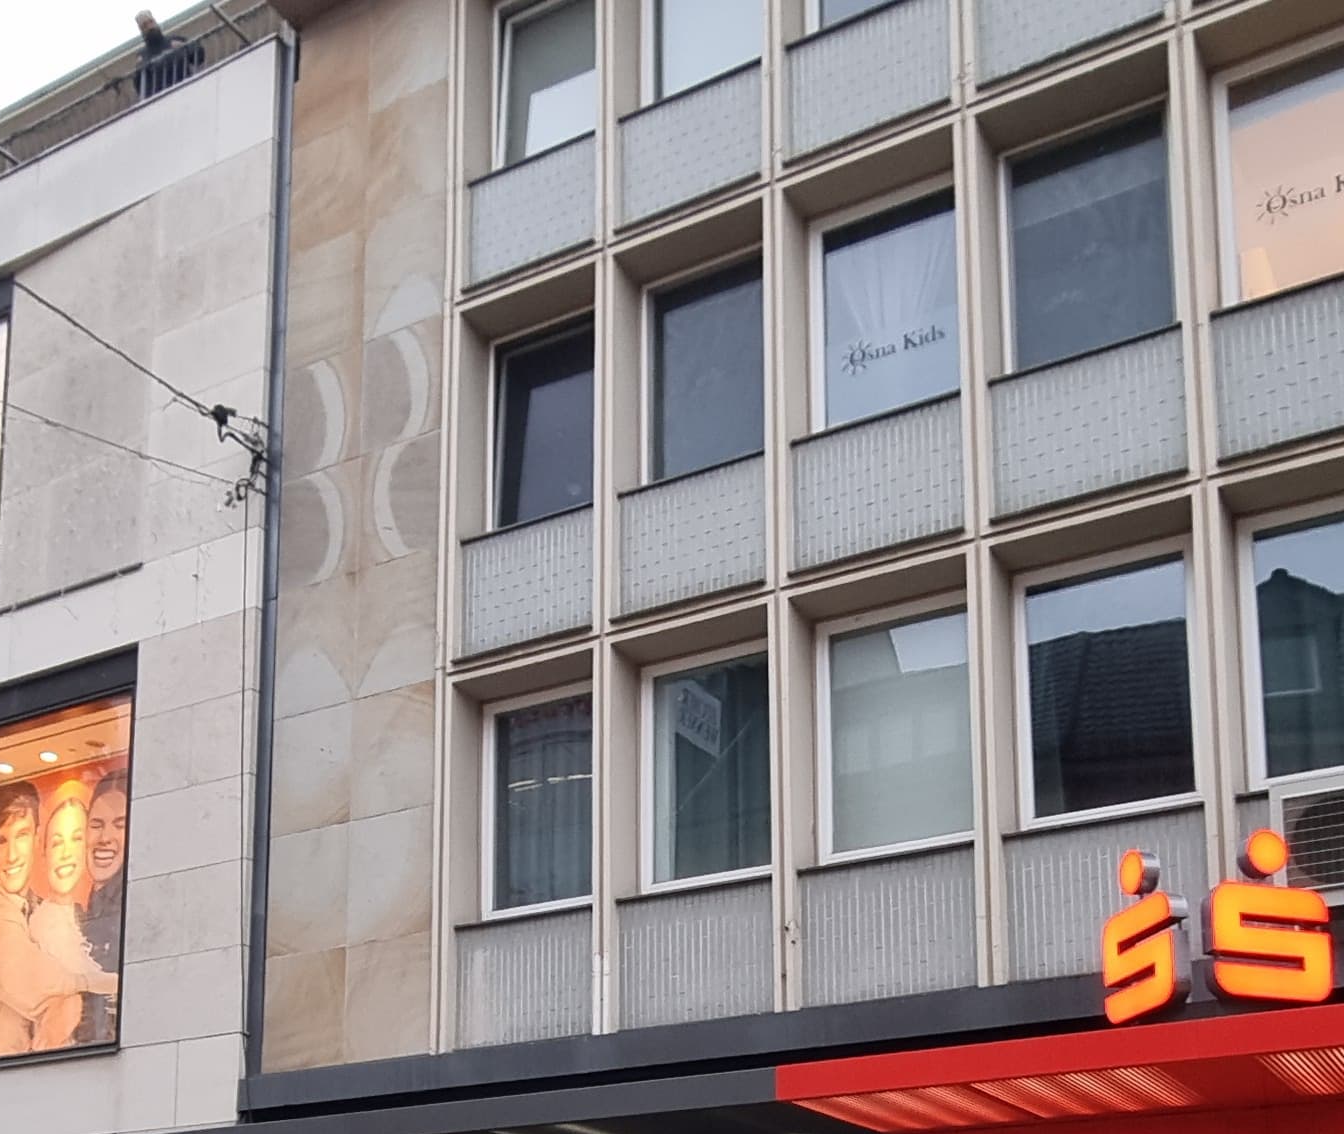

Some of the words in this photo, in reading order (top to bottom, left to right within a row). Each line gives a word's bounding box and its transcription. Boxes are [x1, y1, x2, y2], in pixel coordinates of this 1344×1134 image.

[1263, 184, 1326, 217] Osna
[847, 343, 896, 370] Osna
[903, 324, 946, 350] Kids
